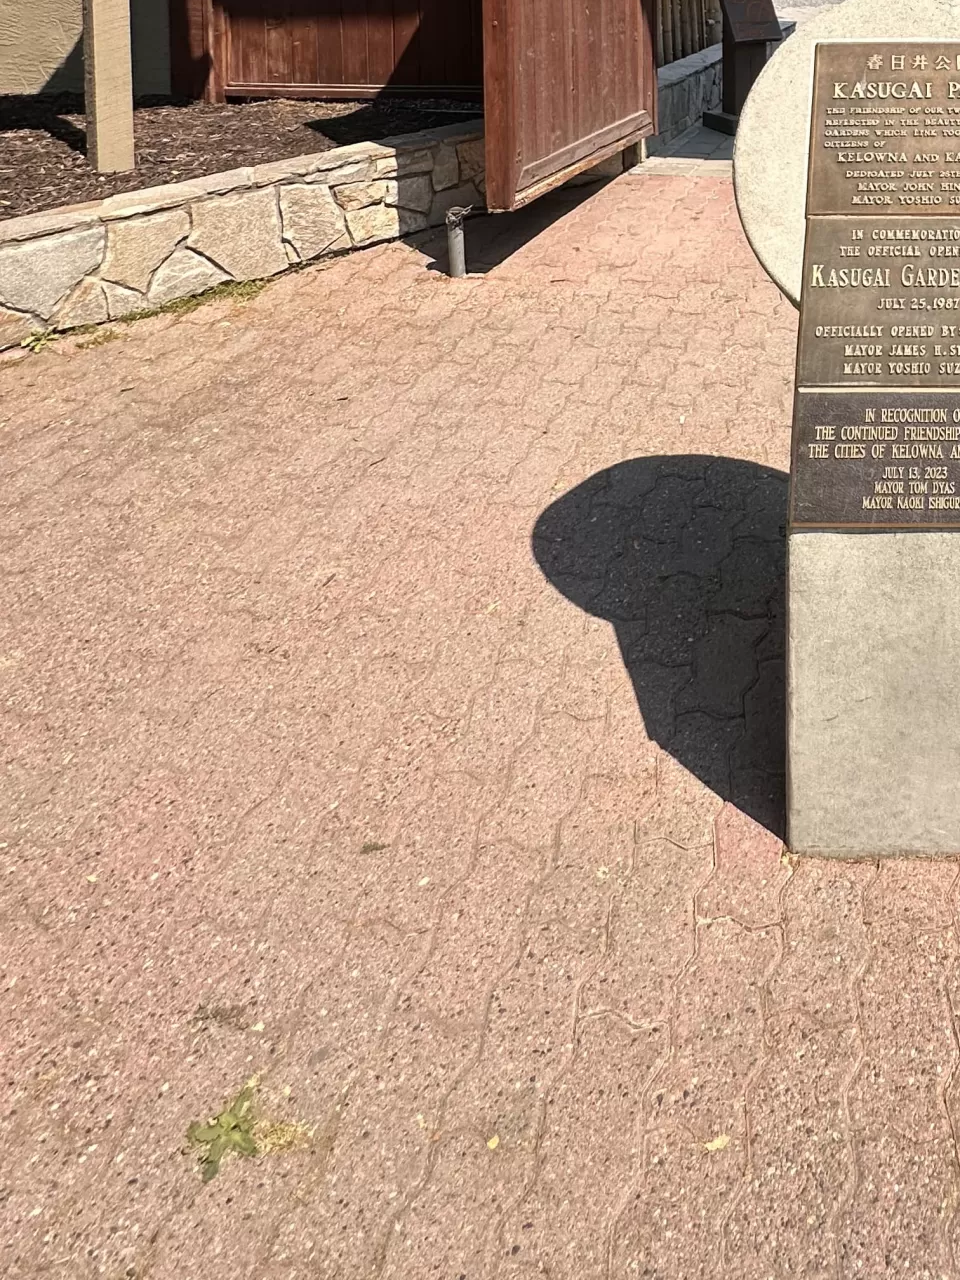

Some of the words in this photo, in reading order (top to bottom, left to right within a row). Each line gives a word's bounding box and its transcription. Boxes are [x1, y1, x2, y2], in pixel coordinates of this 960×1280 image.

[832, 82, 932, 99] KASUGAI
[826, 107, 846, 116] THE
[850, 107, 905, 116] FRIENDSHIP
[908, 107, 920, 116] OF
[924, 107, 944, 116] OUR
[825, 118, 880, 127] REFLECTED
[884, 118, 896, 127] IN
[900, 118, 919, 127] THE
[824, 129, 870, 137] GARDENS
[875, 129, 908, 137] WHICH
[914, 129, 938, 137] LINK
[824, 140, 868, 148] CITIZENS
[874, 140, 886, 148] OF
[837, 152, 908, 163] KELOWNA
[914, 154, 940, 163] AND
[846, 170, 904, 178] DEDICATED
[909, 170, 934, 178] JULY
[858, 182, 897, 192] MAYOR
[903, 182, 934, 192] JOHN
[852, 196, 893, 205] MAYOR
[900, 196, 942, 205] YOSHIO
[852, 229, 864, 240] IN
[840, 246, 860, 257] THE
[868, 246, 920, 257] OFFICIAL
[810, 264, 890, 287] KASUGAI
[877, 298, 906, 310] JULY
[815, 326, 883, 338] OFFICIALLY
[890, 326, 934, 338] OPENED
[844, 344, 882, 356] MAYOR
[889, 344, 926, 356] JAMES
[843, 362, 882, 374] MAYOR
[888, 362, 930, 374] YOSHIO
[865, 408, 876, 422] IN
[881, 408, 947, 422] RECOGNITION
[815, 426, 836, 440] THE
[841, 426, 898, 440] CONTINUED
[904, 426, 960, 440] FRIENDSHIP
[808, 444, 829, 459] THE
[834, 444, 866, 459] CITIES
[872, 444, 885, 459] OF
[892, 444, 943, 459] KELOWNA
[882, 467, 904, 480] JULY
[925, 467, 948, 480] 2023
[874, 482, 904, 494] MAYOR
[910, 482, 928, 494] TOM
[933, 482, 955, 494] DYAS
[862, 496, 892, 510] MAYOR
[898, 496, 924, 510] NAOKI
